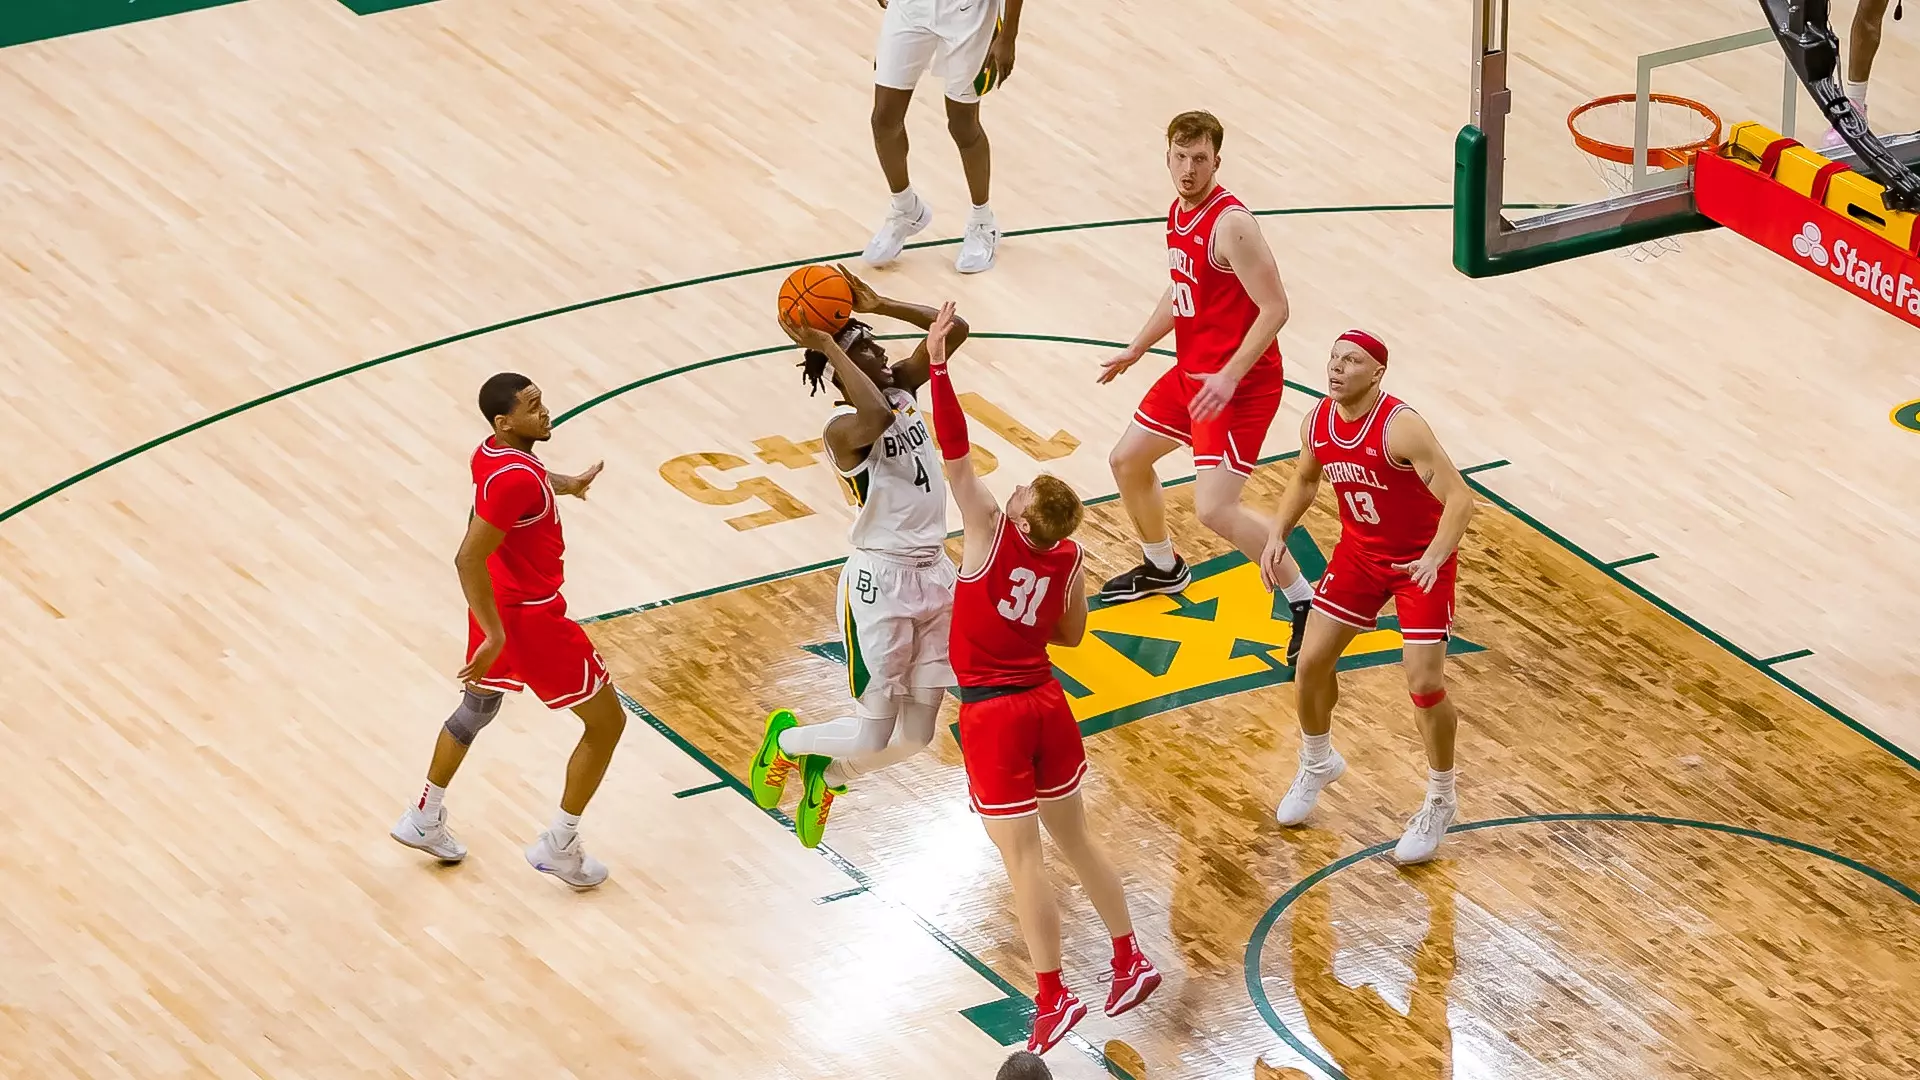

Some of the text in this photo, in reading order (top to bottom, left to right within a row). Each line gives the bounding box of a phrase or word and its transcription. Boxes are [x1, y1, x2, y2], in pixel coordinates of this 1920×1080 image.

[914, 455, 931, 493] 4
[1322, 461, 1389, 490] CORNELL
[1344, 491, 1380, 525] 13
[856, 568, 878, 605] BU
[997, 566, 1050, 627] 31
[1319, 572, 1334, 595] C
